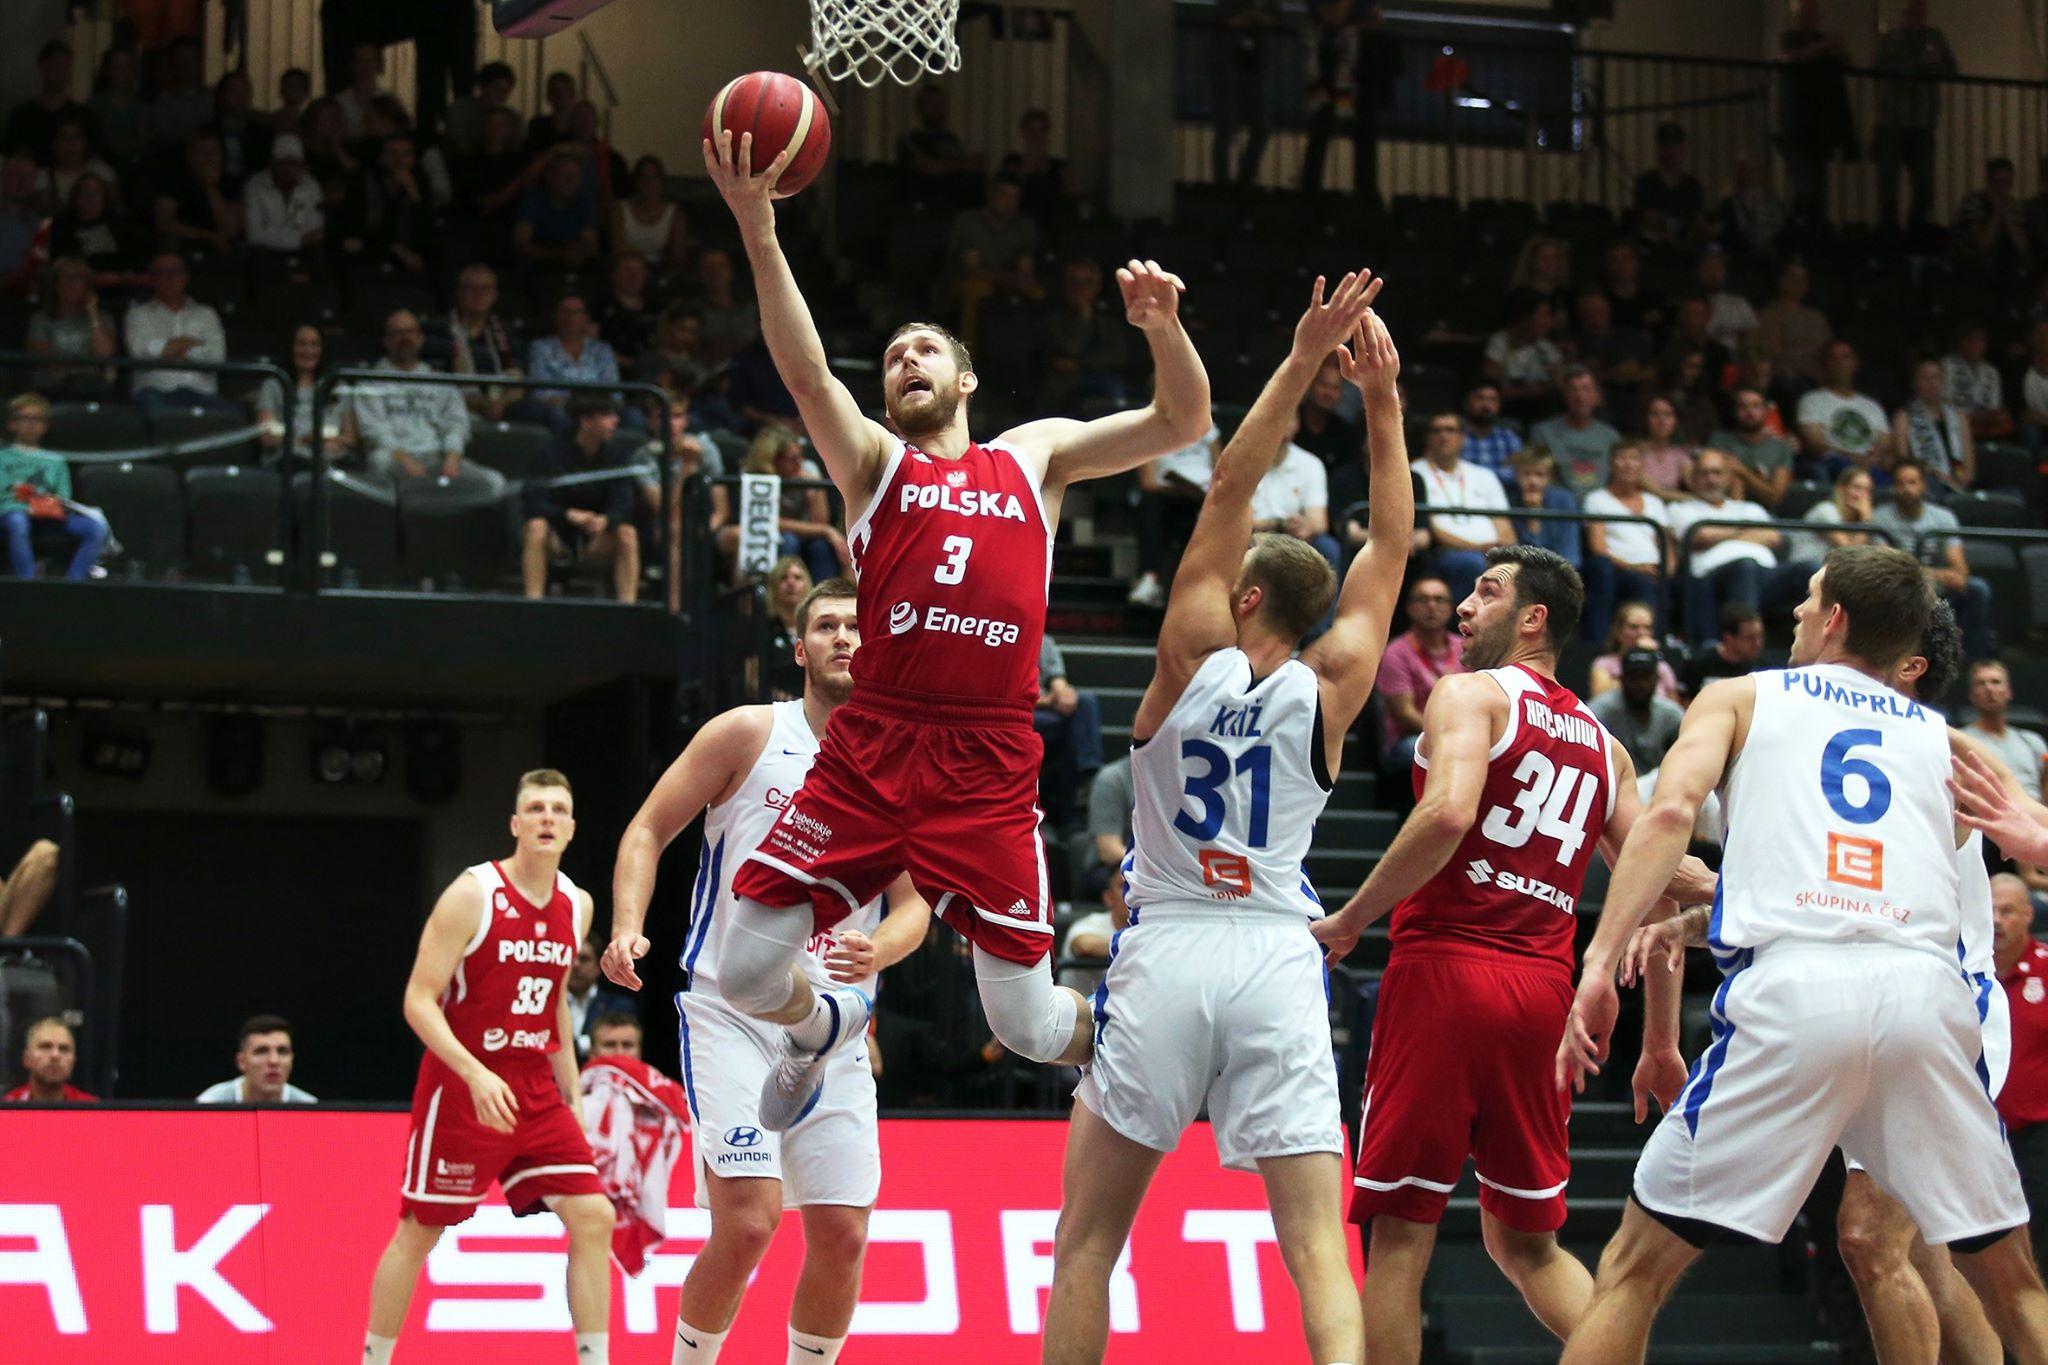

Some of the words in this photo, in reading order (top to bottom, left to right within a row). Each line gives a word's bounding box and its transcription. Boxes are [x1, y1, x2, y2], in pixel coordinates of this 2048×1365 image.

[901, 484, 1025, 522] POLSKA
[934, 535, 973, 585] 3
[924, 607, 1019, 647] Energa
[1783, 671, 1926, 723] PUMPRLA
[1173, 739, 1272, 847] 31
[1820, 728, 1892, 824] 6
[1481, 750, 1599, 867] 34
[1496, 871, 1574, 915] SUZUKI
[1796, 891, 1873, 916] SKUPINA
[1880, 901, 1912, 925] ČEZ
[498, 940, 573, 966] POLSKA
[511, 976, 553, 1014] 33
[718, 1151, 772, 1165] HYUNDAI
